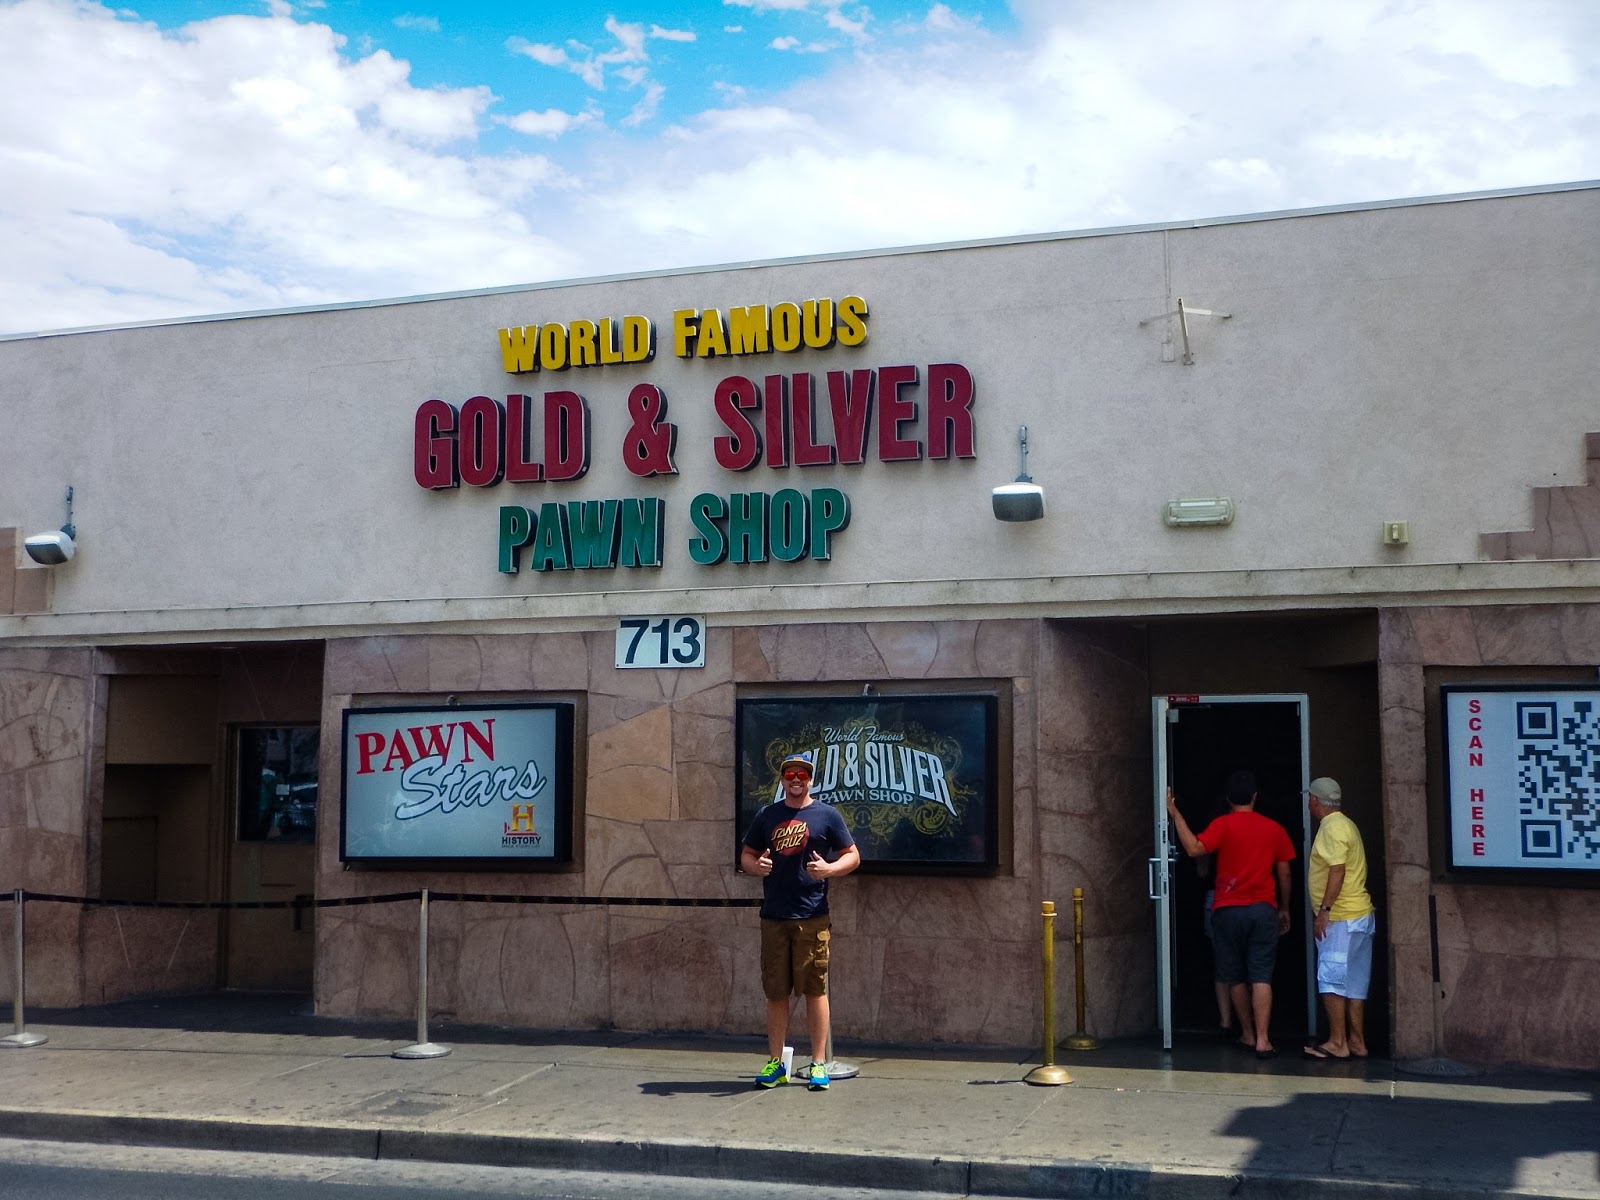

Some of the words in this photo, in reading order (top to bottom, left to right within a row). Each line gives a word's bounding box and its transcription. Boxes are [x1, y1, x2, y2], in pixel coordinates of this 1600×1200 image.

[499, 315, 653, 373] WORLD
[674, 296, 869, 359] FAMOUS
[414, 390, 591, 489] GOLD
[622, 383, 678, 477] &
[714, 363, 977, 472] SILVER
[499, 497, 665, 573] PAWN
[688, 488, 850, 565] SHOP
[619, 617, 701, 665] 713
[355, 718, 496, 775] PAWN
[824, 726, 863, 743] World
[865, 726, 905, 742] Famous
[1469, 699, 1484, 767] SCAN
[395, 754, 548, 820] Stars
[773, 744, 840, 804] LD
[843, 742, 860, 788] &
[865, 742, 959, 817] SILVER
[819, 789, 865, 804] PAWN
[869, 790, 914, 805] SHOP
[501, 836, 542, 845] HISTORY
[511, 803, 535, 832] H
[771, 821, 807, 840] SANTA
[775, 834, 804, 852] CRUZ
[1470, 788, 1485, 856] HERE
